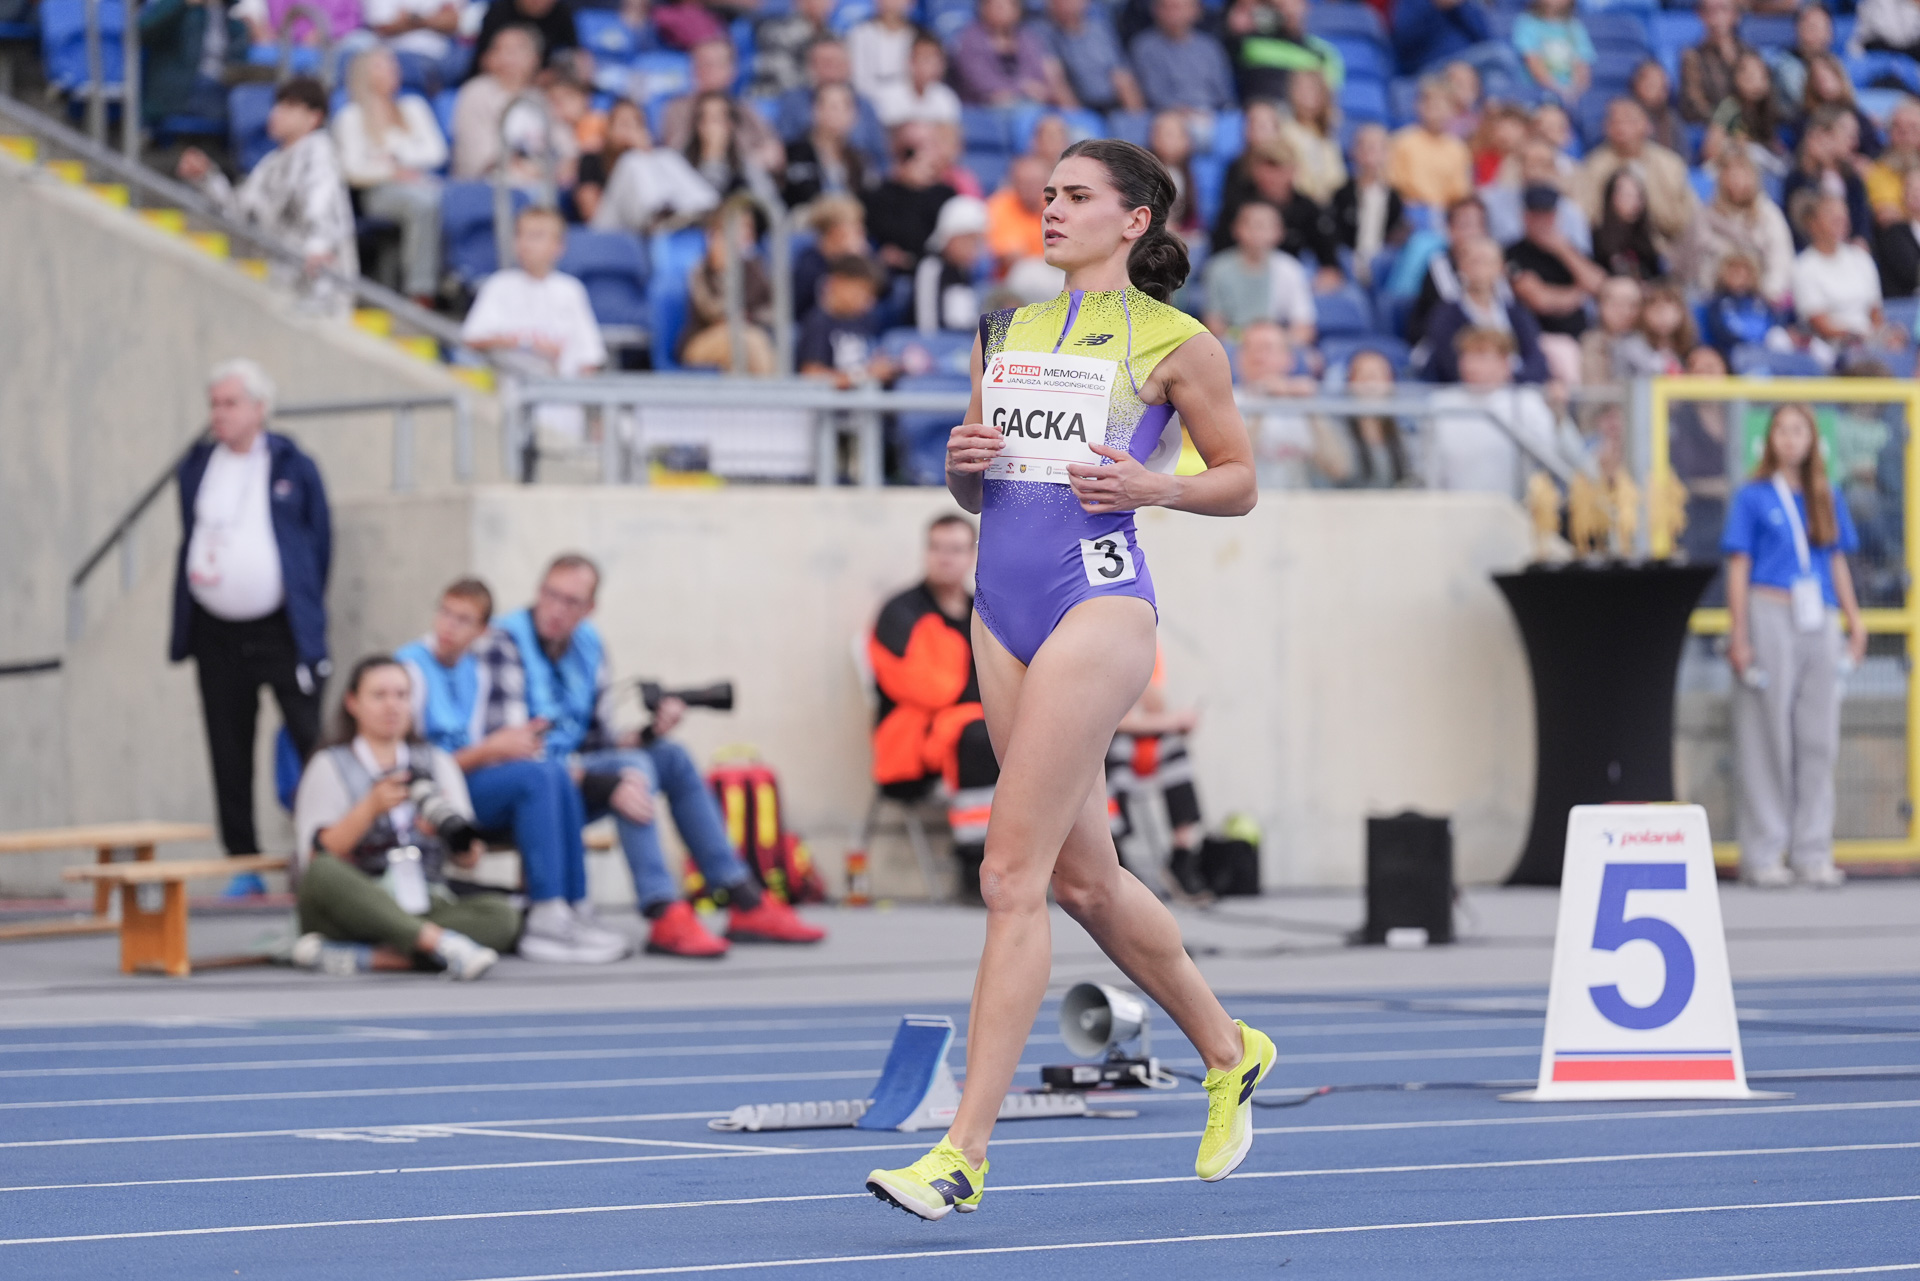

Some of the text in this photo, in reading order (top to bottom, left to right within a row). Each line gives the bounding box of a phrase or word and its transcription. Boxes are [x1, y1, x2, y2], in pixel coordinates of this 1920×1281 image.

[1007, 378, 1106, 391] JANUSZA KUSOCIŃSKIEGO
[1010, 365, 1040, 376] ORLEN
[1043, 368, 1106, 382] MEMORIAŁ
[992, 407, 1087, 443] GACKA
[1094, 539, 1125, 579] 3
[1620, 828, 1686, 847] polanik
[1588, 862, 1696, 1031] 5
[928, 1169, 975, 1206] N
